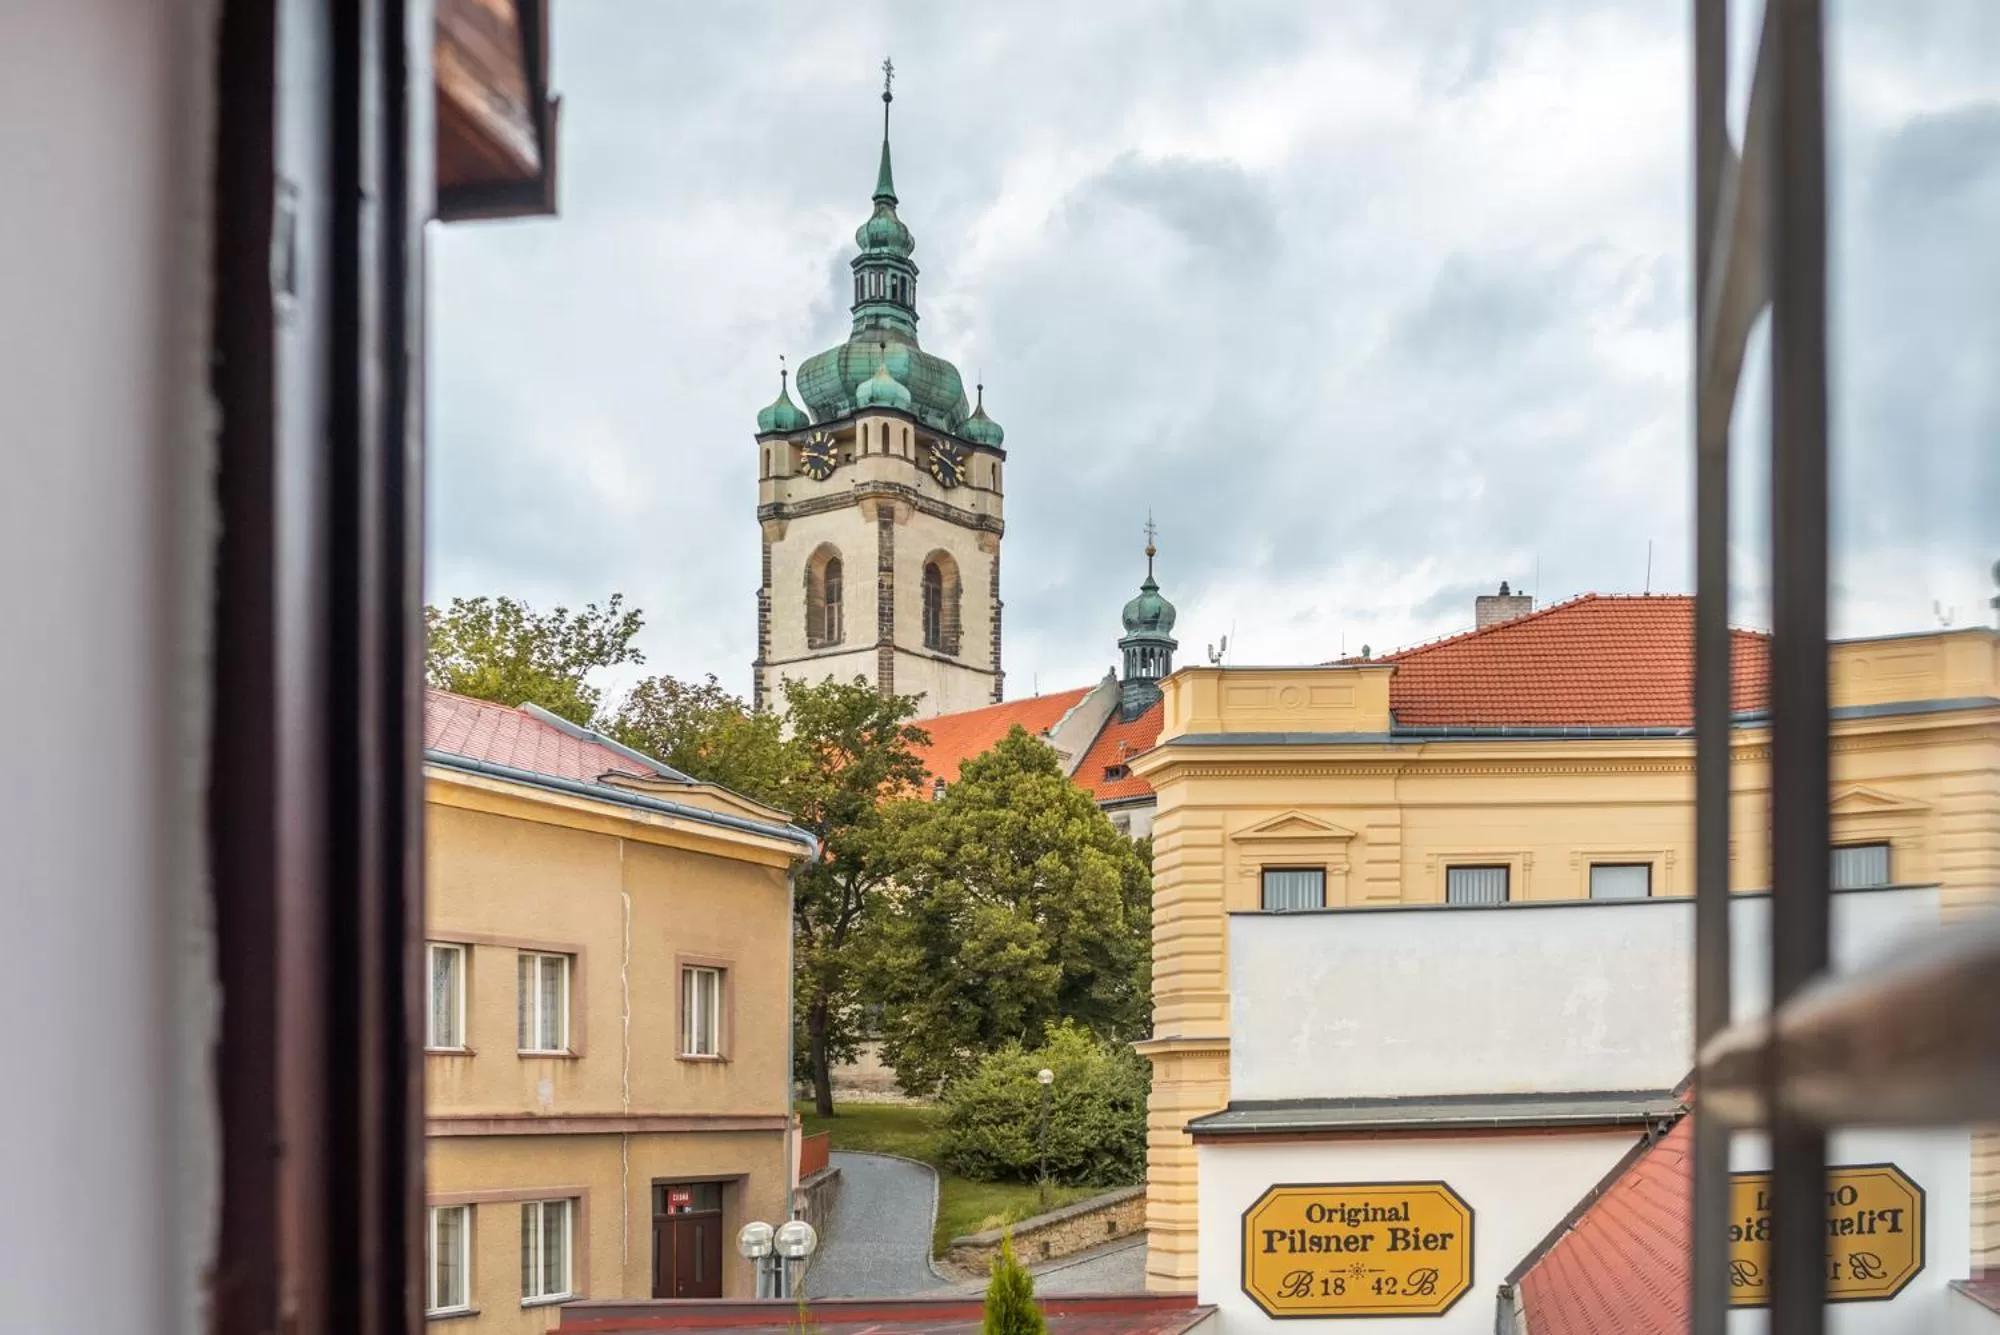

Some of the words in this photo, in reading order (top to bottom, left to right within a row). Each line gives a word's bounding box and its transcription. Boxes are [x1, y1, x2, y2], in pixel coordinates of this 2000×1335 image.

[1305, 1201, 1410, 1228] Original
[1262, 1229, 1375, 1254] Pilsner
[1386, 1227, 1455, 1252] Bier
[1320, 1277, 1346, 1296] 18
[1371, 1276, 1398, 1295] 42
